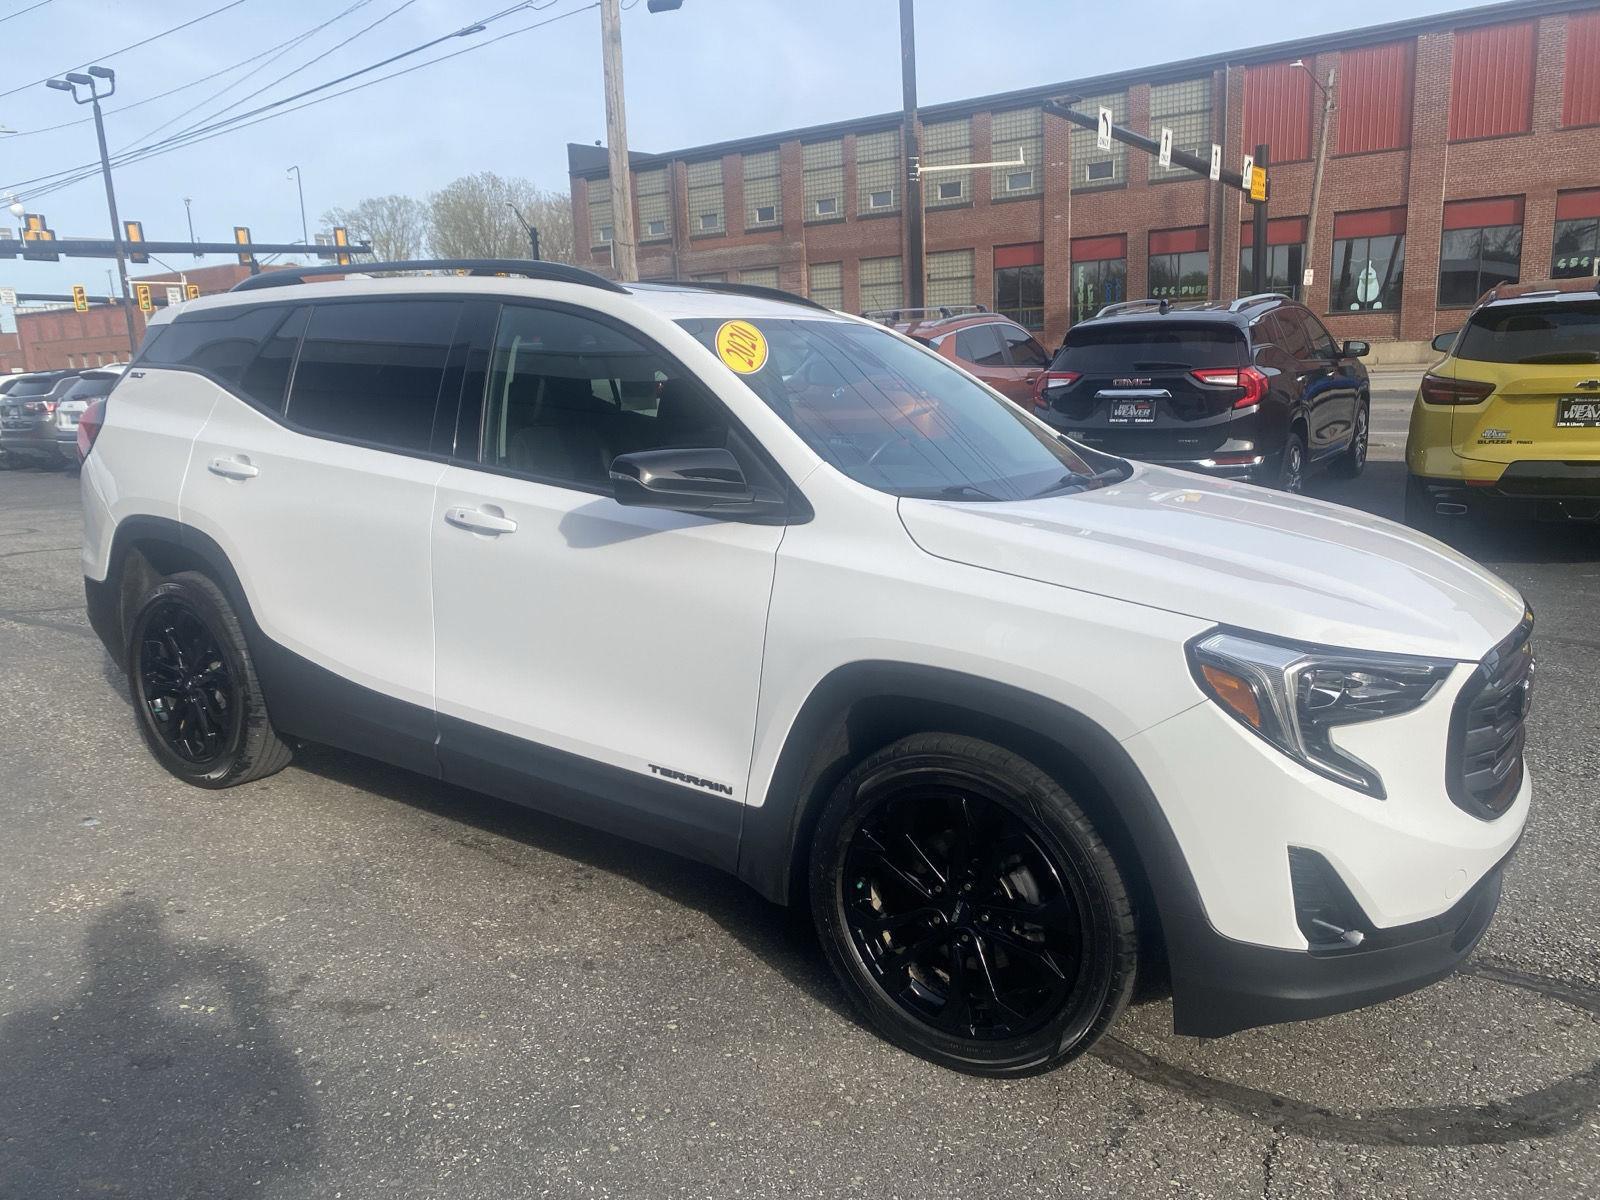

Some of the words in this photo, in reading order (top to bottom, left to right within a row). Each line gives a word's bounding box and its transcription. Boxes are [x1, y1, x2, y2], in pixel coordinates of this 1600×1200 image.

[725, 324, 758, 368] 2020
[1112, 378, 1152, 386] GMC
[1570, 404, 1596, 412] RICK
[647, 763, 733, 796] TERRAIN
